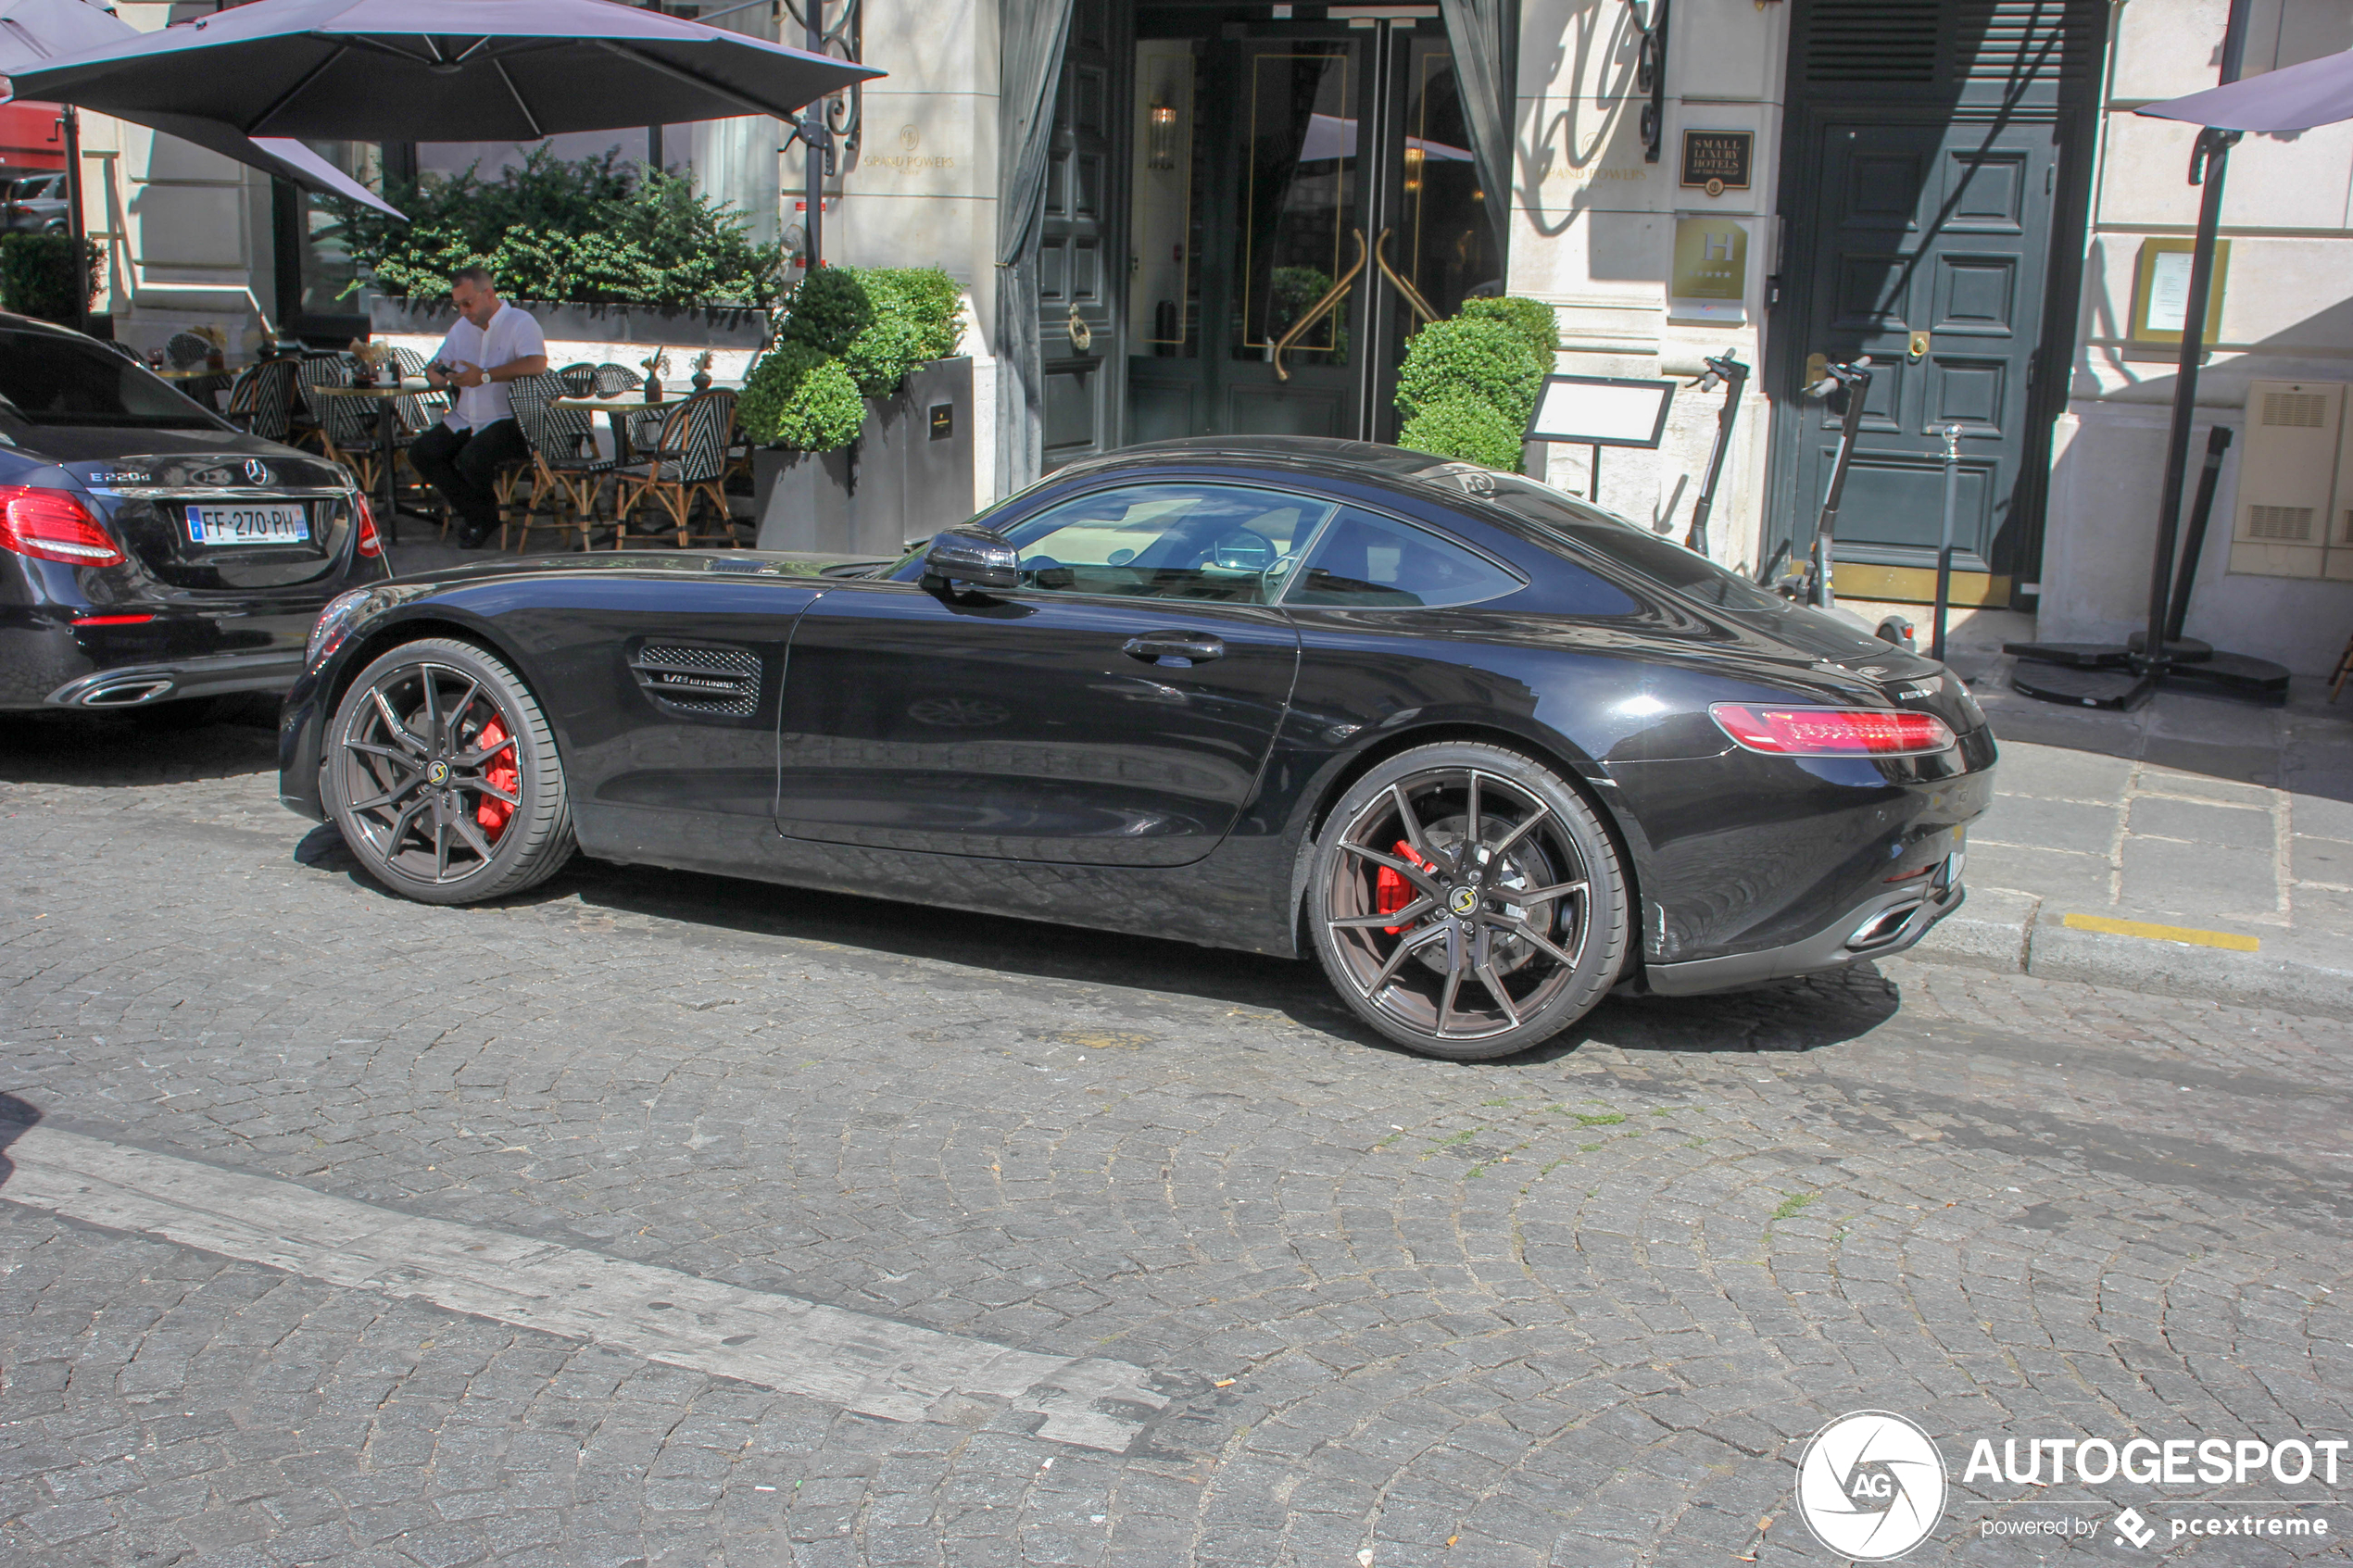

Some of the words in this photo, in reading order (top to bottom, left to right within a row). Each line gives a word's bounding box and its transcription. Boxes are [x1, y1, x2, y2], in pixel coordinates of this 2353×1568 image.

[1695, 140, 1741, 149] SMALL
[1694, 149, 1738, 158] LUXURY
[863, 156, 904, 167] GRAND
[908, 157, 954, 168] POWERS
[1693, 159, 1739, 169] HOTELS
[1589, 169, 1647, 181] POWERS
[1702, 232, 1734, 261] H
[90, 472, 103, 482] E
[663, 674, 688, 684] V8
